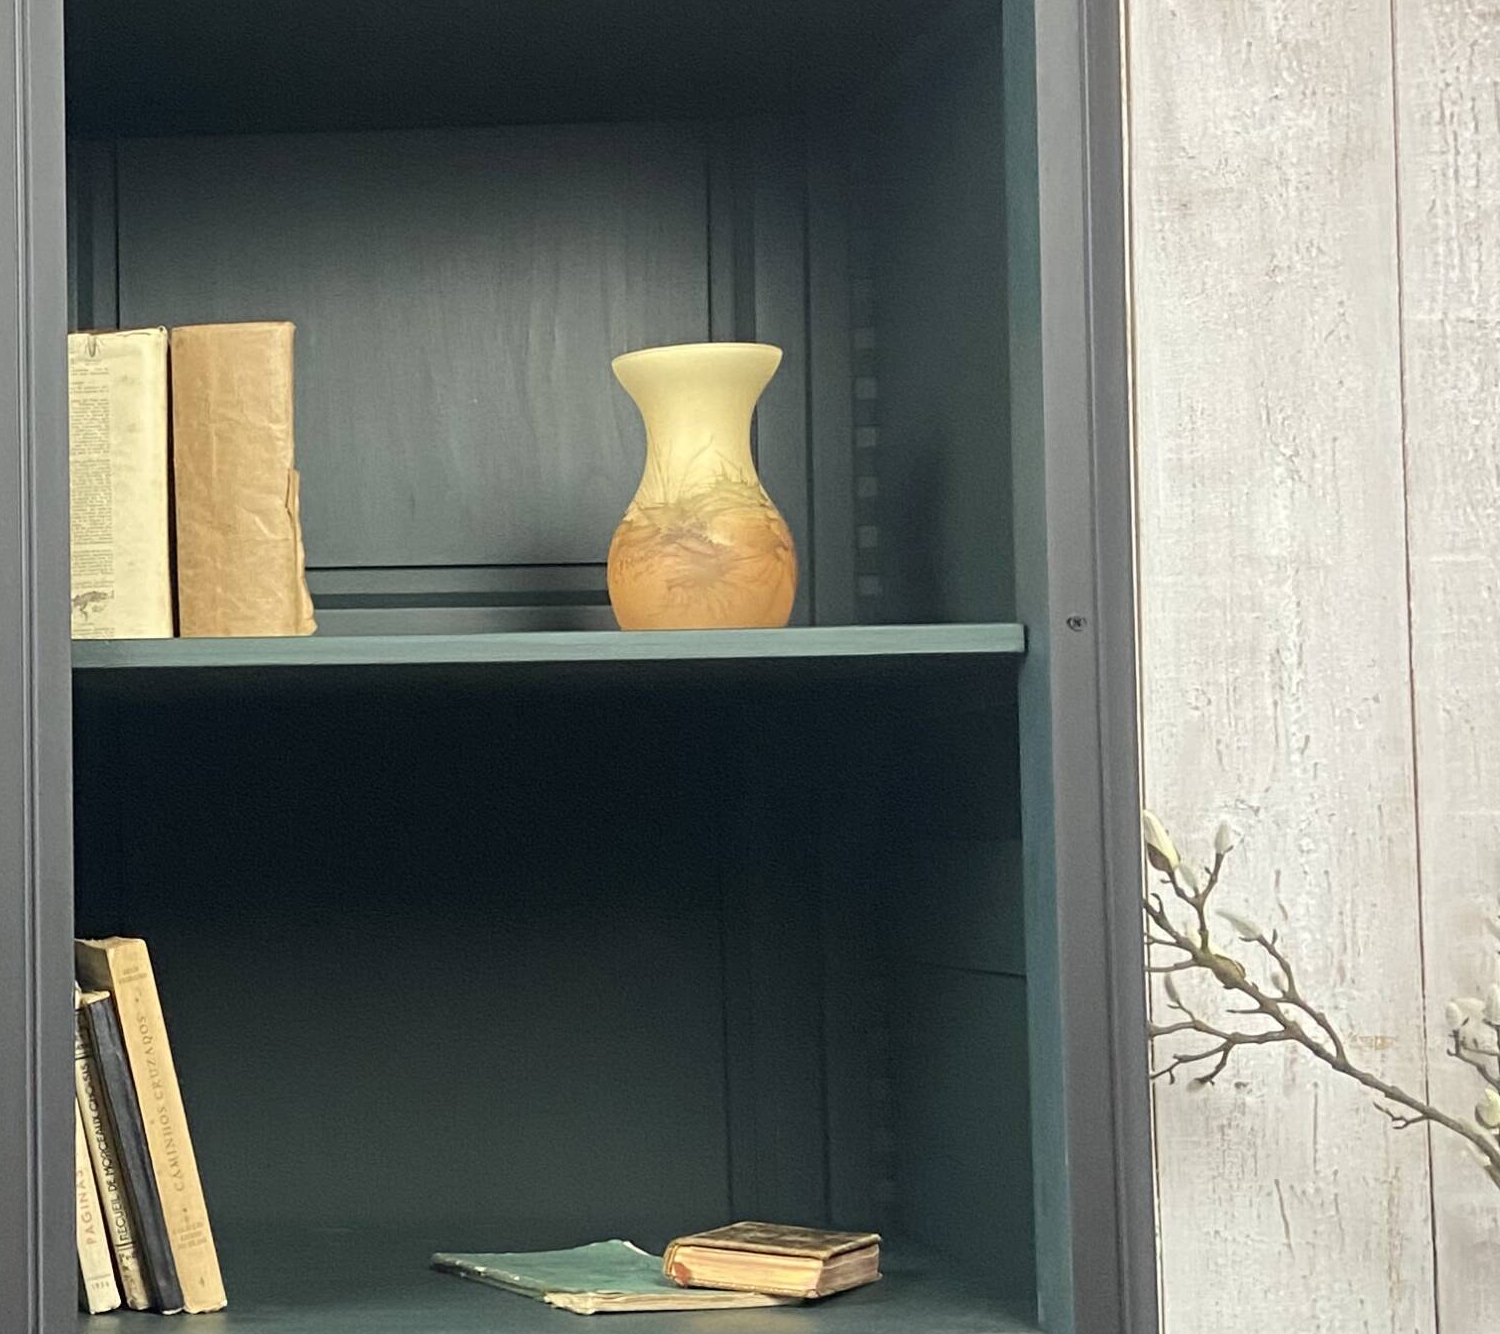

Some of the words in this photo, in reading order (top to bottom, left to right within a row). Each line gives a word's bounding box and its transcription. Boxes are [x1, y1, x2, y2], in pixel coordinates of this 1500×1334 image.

[139, 1015, 165, 1100] CRUZADOS
[92, 1115, 115, 1176] MORCEAUX
[157, 1106, 186, 1192] CAMINHOS
[107, 1181, 118, 1192] DE
[111, 1194, 129, 1242] RECUEIL
